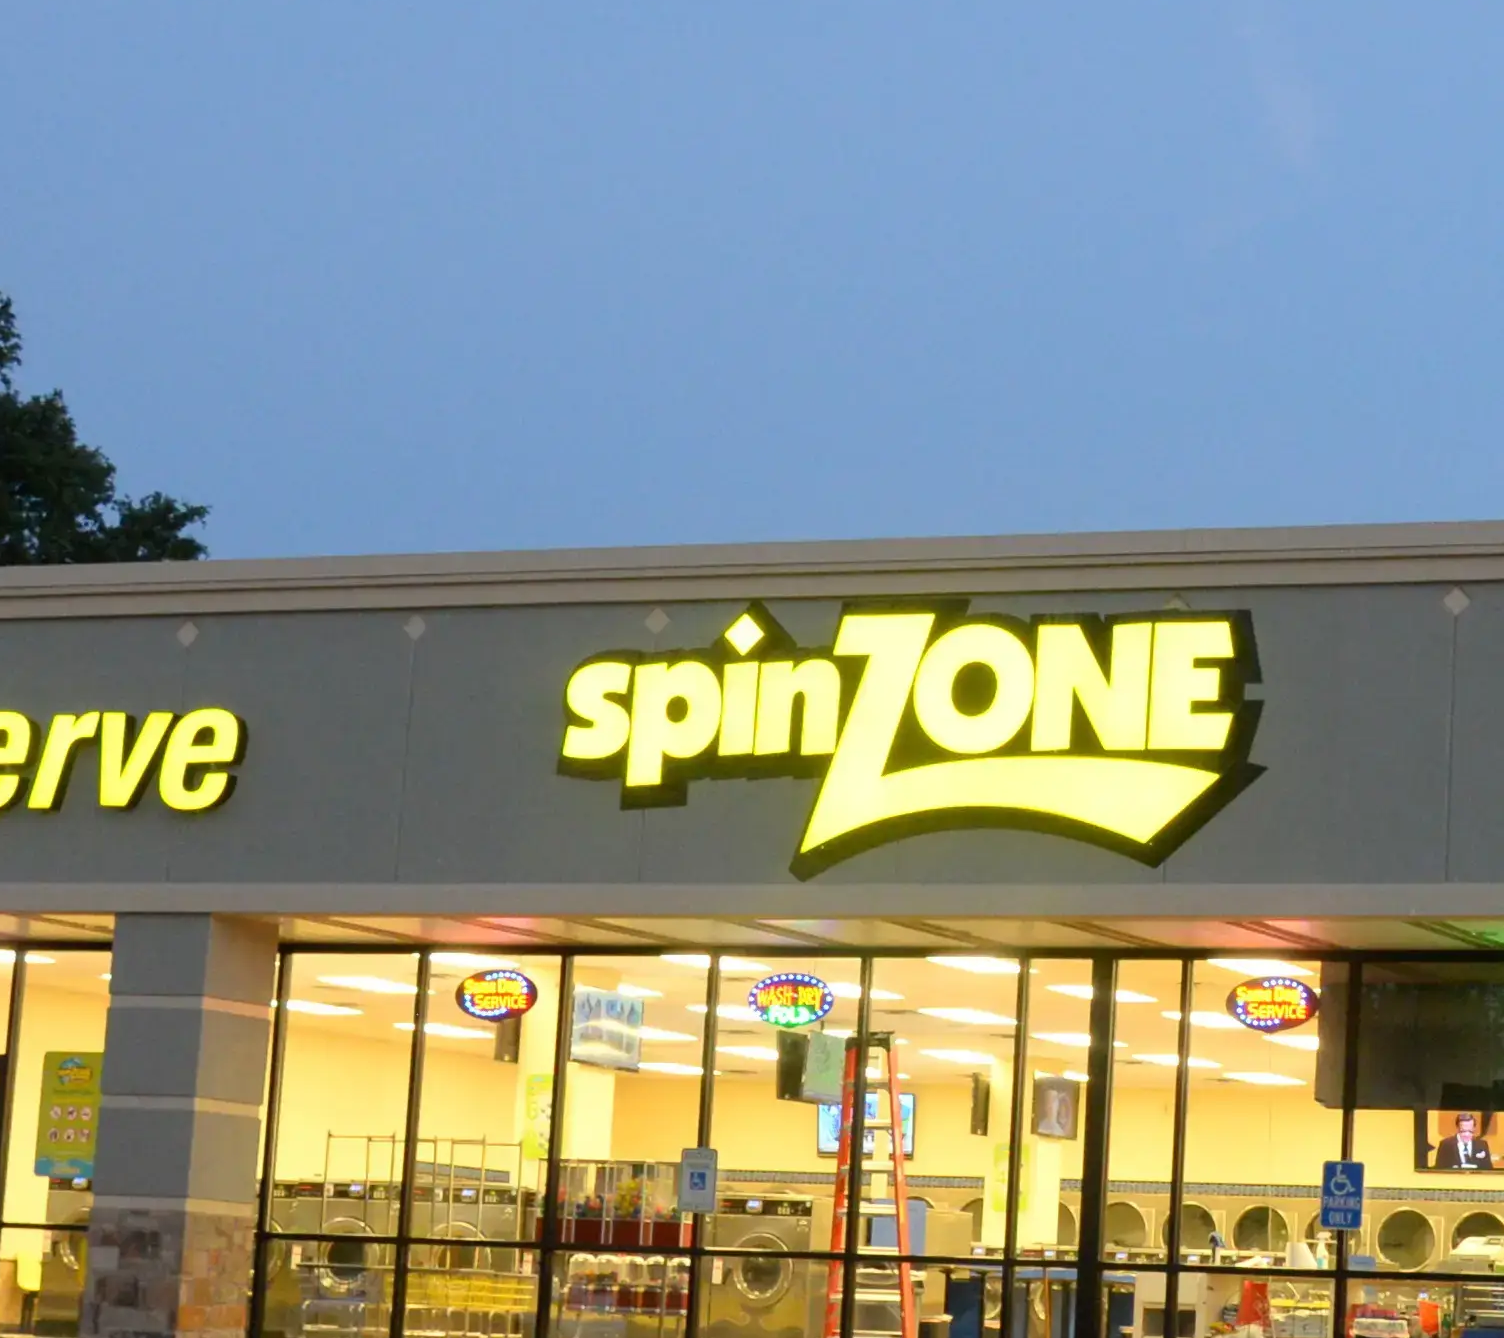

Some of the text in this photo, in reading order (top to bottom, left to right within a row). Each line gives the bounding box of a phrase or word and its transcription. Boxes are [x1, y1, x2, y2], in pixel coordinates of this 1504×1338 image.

[473, 994, 527, 1010] SERVICE
[1247, 1003, 1306, 1020] SERVICE
[1328, 1211, 1353, 1225] ONLY
